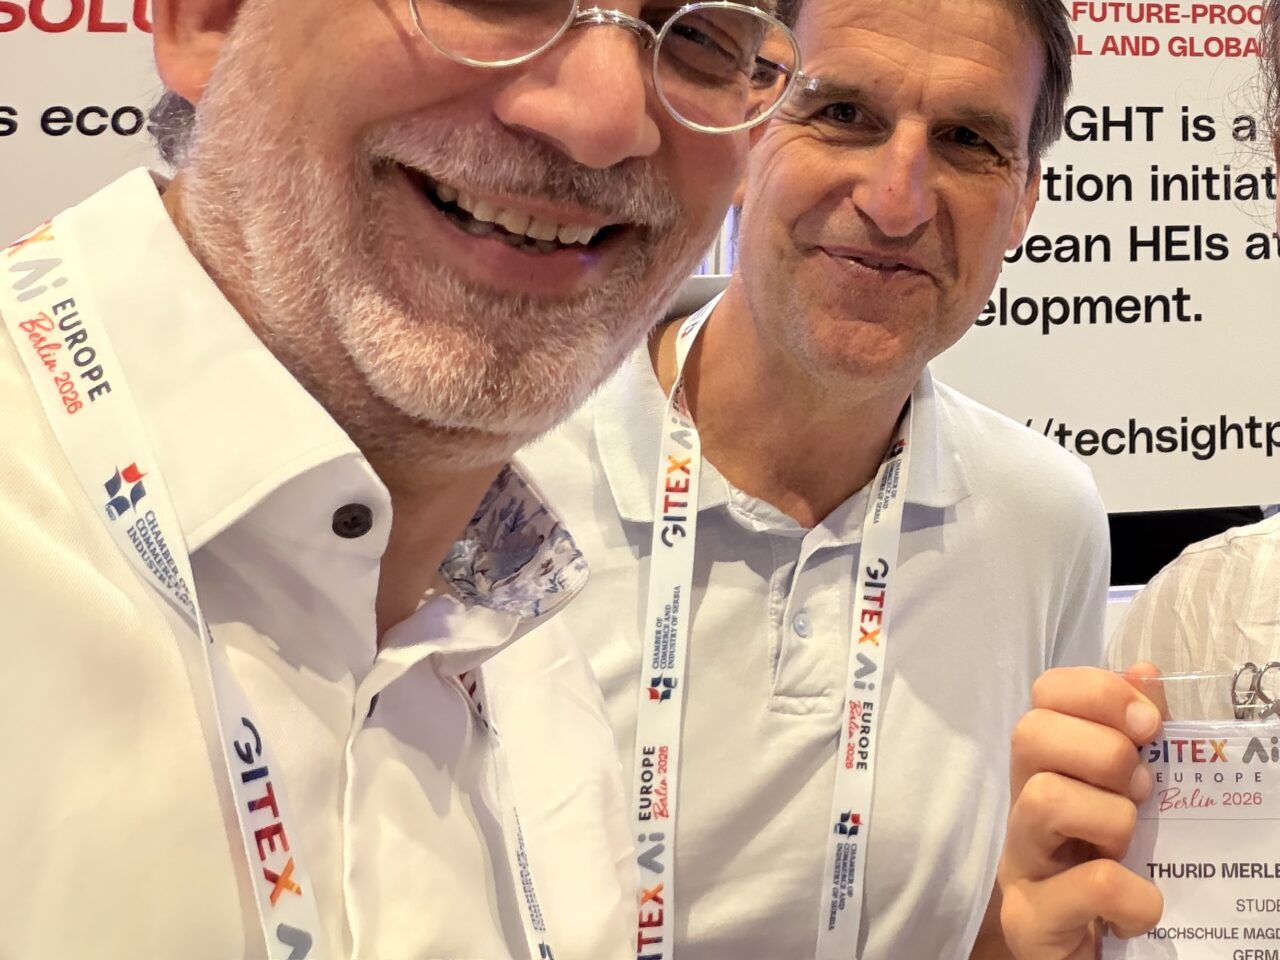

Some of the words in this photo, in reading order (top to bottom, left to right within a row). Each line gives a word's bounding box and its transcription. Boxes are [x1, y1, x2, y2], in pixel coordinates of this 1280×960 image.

[1100, 35, 1161, 57] AND
[1167, 36, 1264, 58] GLOBA
[40, 105, 151, 137] eco
[1063, 105, 1164, 142] GHT
[1181, 105, 1216, 142] is
[1232, 114, 1257, 142] a
[1038, 164, 1133, 202] tion
[1150, 164, 1277, 203] initiat
[1129, 225, 1229, 262] HEIs
[974, 286, 1203, 335] elopment.
[18, 311, 63, 373] Berlin
[54, 371, 84, 415] 2026
[52, 297, 112, 403] EUROPE
[661, 455, 692, 548] GITEX
[145, 510, 179, 576] CHAMBER
[858, 557, 889, 647] GITEX
[856, 701, 874, 770] EUROPE
[657, 745, 669, 774] 2026
[1156, 771, 1262, 783] EUROPE
[638, 745, 656, 822] EUROPE
[653, 778, 669, 821] Berlin
[1158, 786, 1217, 813] Berlin
[1222, 791, 1263, 806] 2026
[233, 716, 303, 907] GITEX
[1147, 862, 1216, 879] THURID
[1147, 927, 1239, 940] HOCHSCHULE
